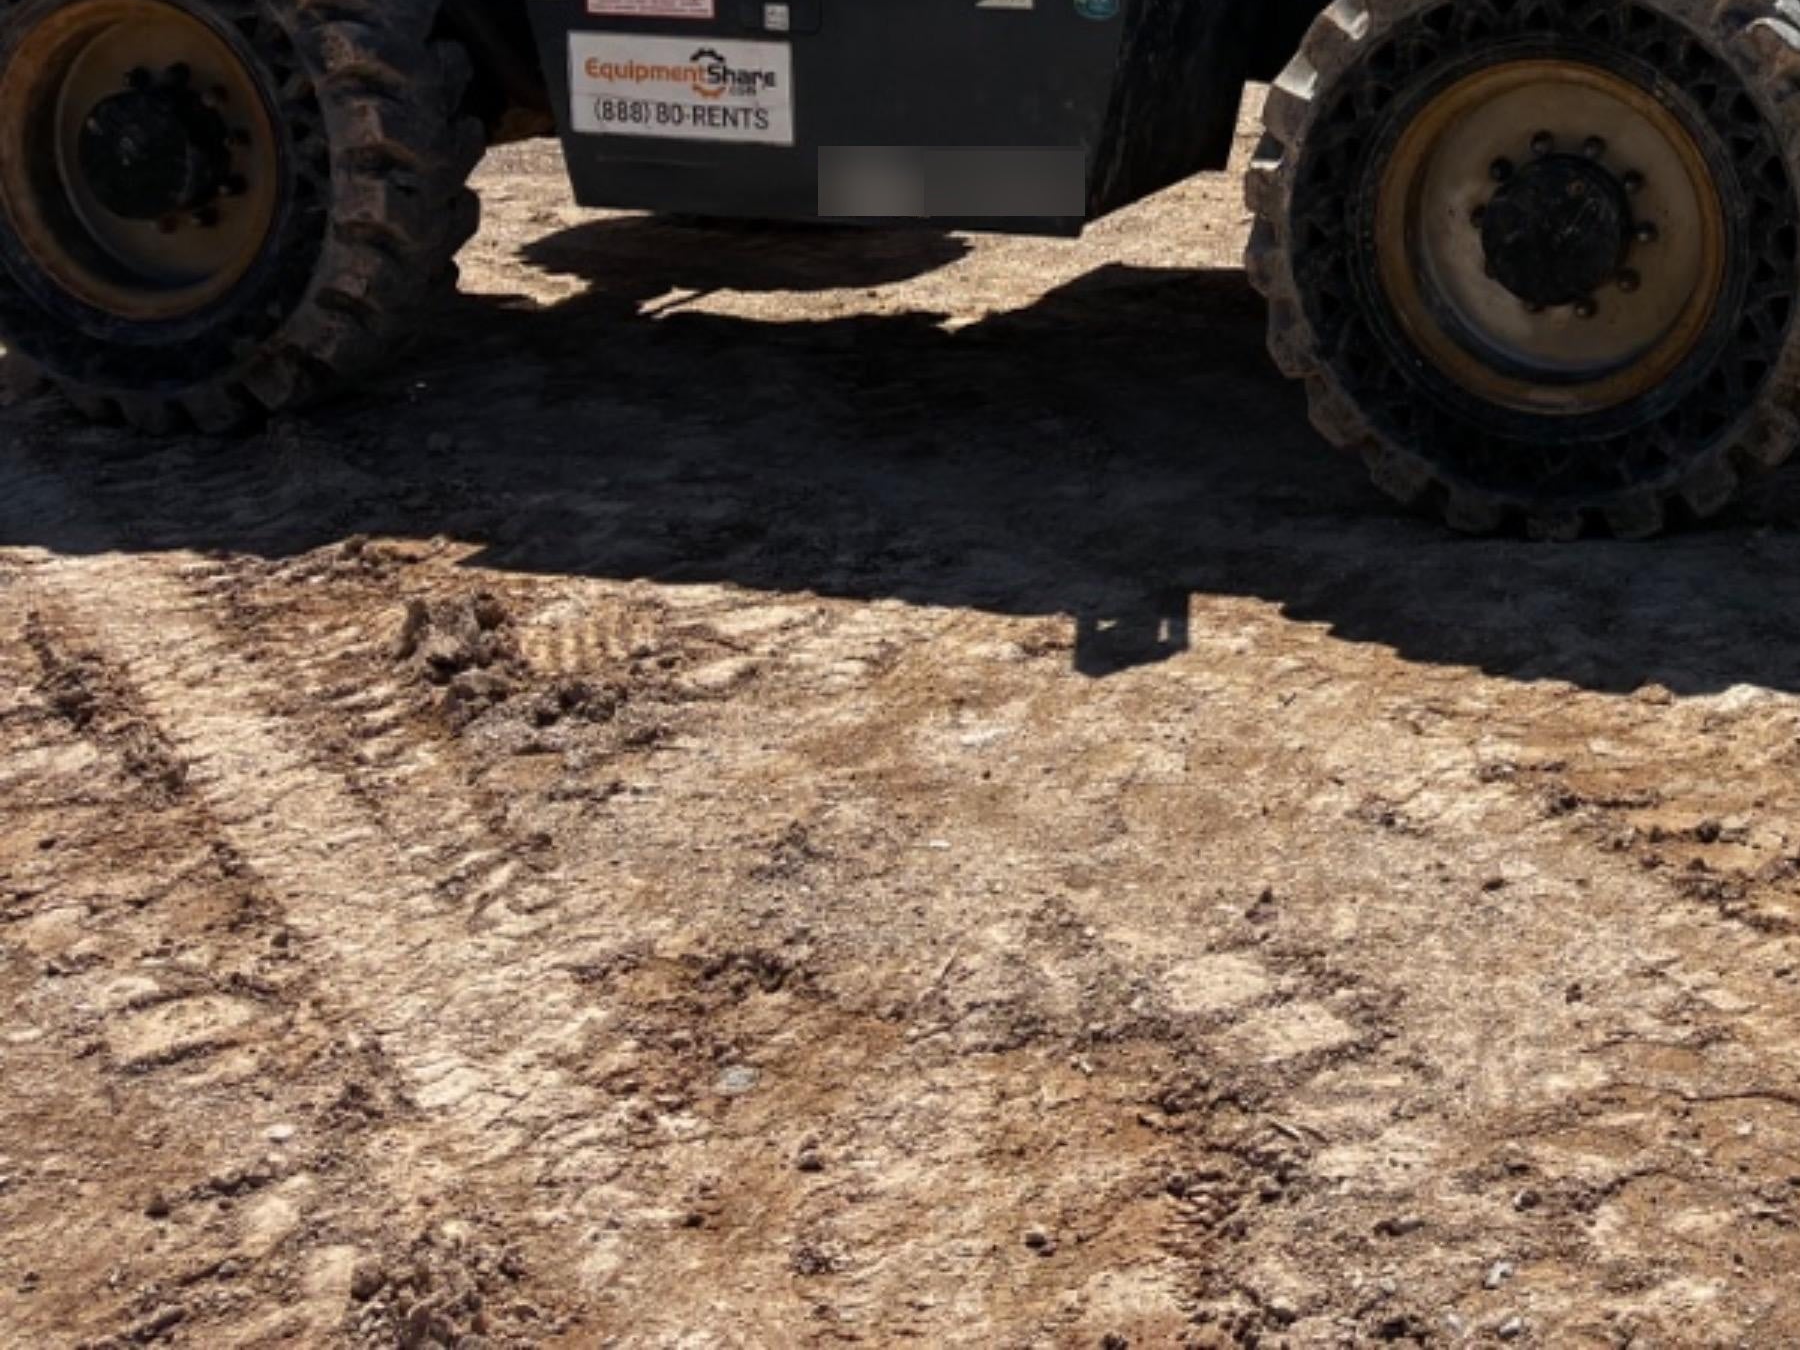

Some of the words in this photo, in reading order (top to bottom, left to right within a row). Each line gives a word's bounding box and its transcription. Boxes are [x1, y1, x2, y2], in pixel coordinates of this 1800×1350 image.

[584, 56, 777, 88] EquipmentShare
[594, 97, 650, 125] (888)
[656, 101, 770, 131] 80-RENTS
